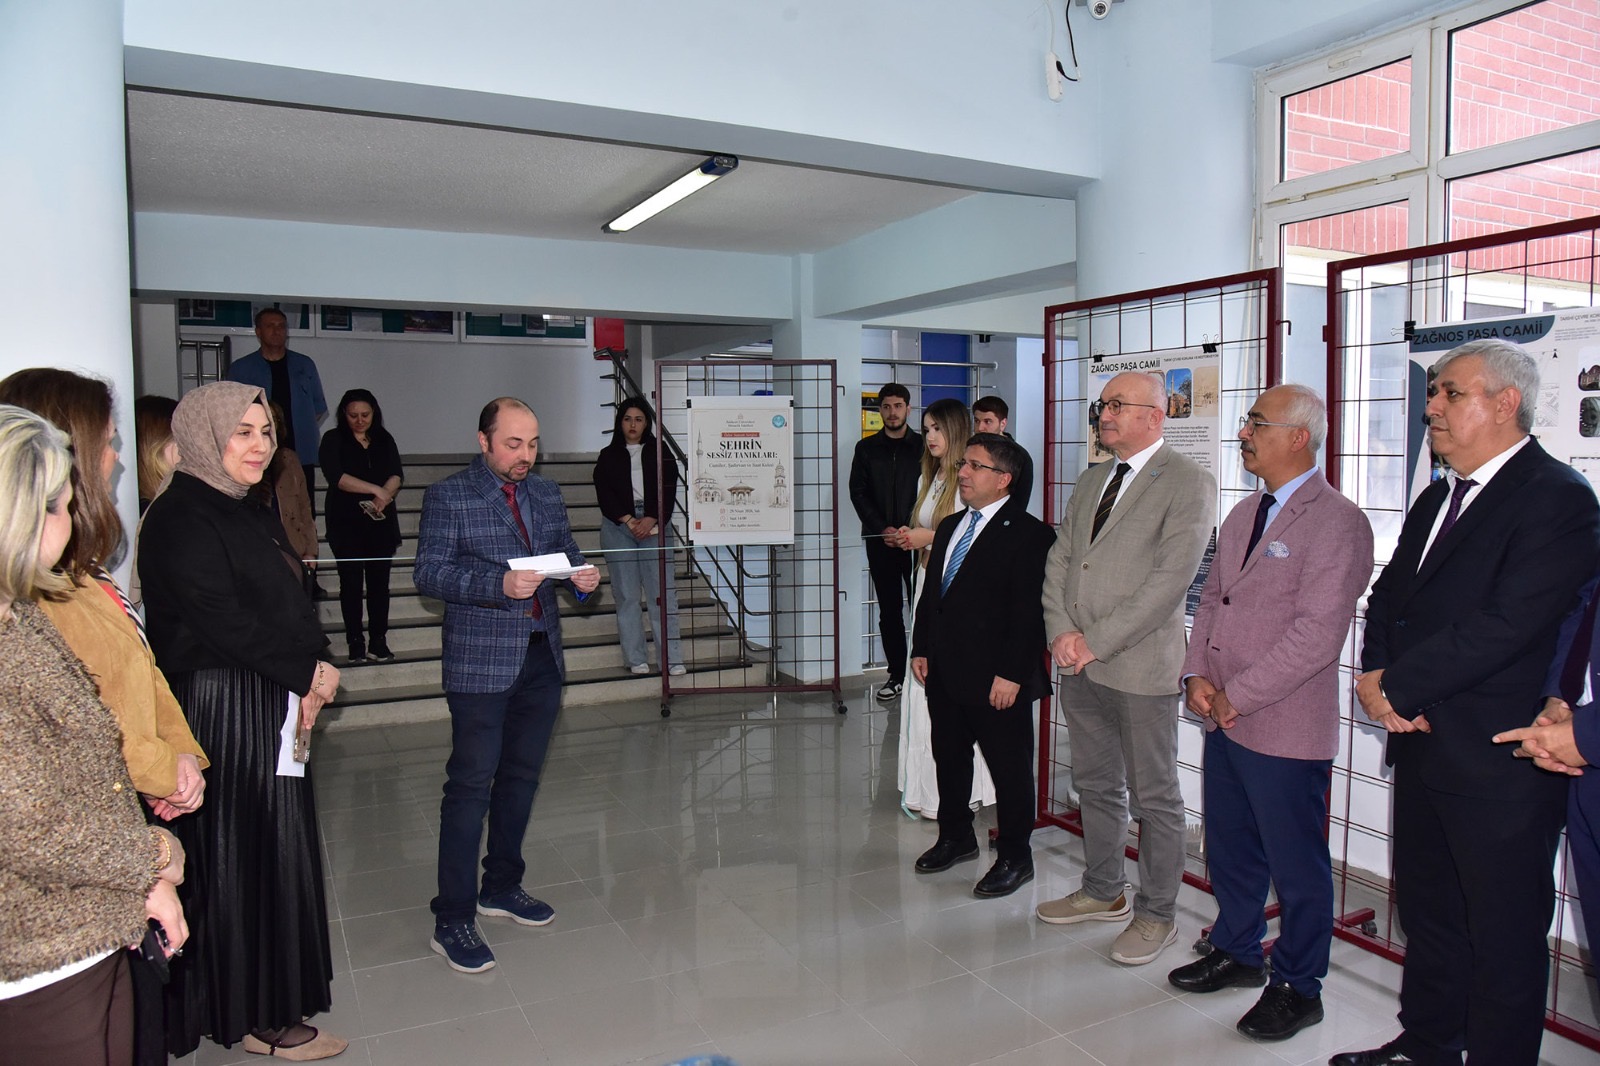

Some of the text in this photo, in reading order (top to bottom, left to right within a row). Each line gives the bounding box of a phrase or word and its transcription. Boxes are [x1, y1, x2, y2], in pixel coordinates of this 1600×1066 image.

[1413, 330, 1464, 345] ZAĞNOS
[1503, 320, 1542, 337] CAMİİ
[1091, 363, 1119, 373] ZAĞNOS
[1120, 361, 1137, 371] PAŞA
[719, 438, 762, 452] ŞEHRİN
[706, 451, 733, 459] SESSİZ
